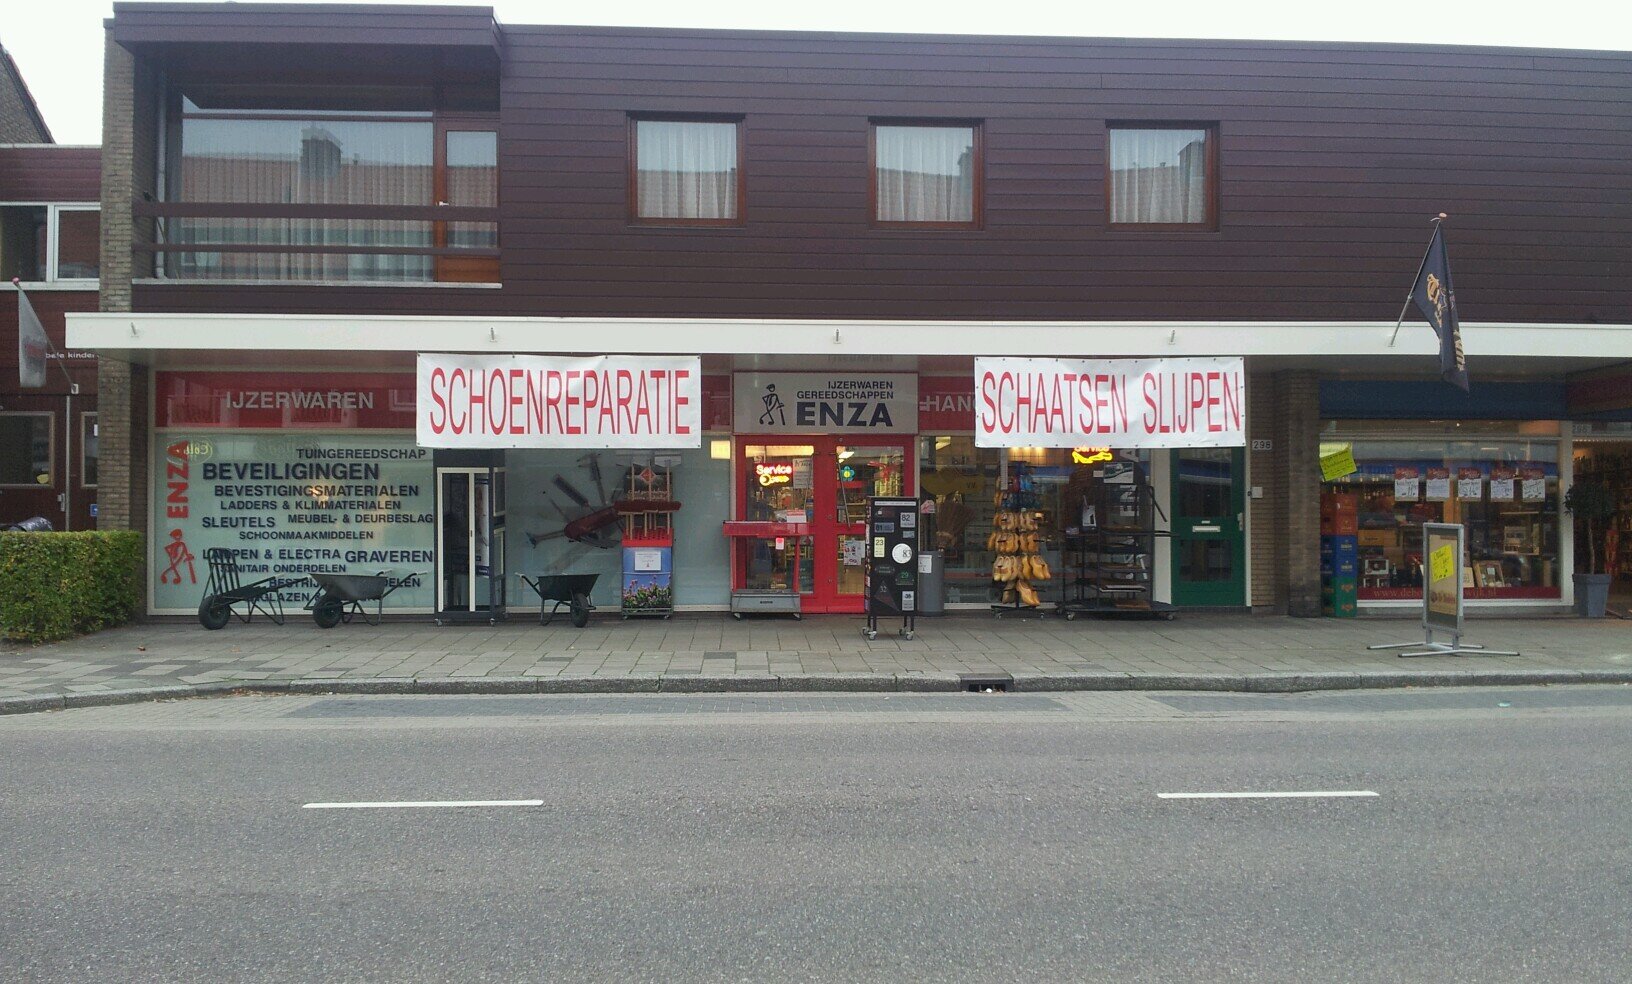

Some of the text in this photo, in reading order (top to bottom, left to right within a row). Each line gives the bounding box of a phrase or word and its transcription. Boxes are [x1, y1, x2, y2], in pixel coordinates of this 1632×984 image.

[828, 380, 893, 390] IJZERWAREN
[226, 391, 373, 409] IJZERWAREN
[430, 367, 690, 435] SCHOENREPARATIE
[797, 390, 894, 400] GEREEDSCHAPPEN
[926, 395, 975, 411] HAN
[981, 371, 1240, 434] SCHAATSEN SLIJPEN
[796, 402, 893, 427] ENZA
[296, 448, 426, 460] TUINGEREEDSCHAP
[202, 463, 379, 480] BEVEILIGINGEN
[756, 464, 792, 474] Service
[166, 440, 190, 518] ENZA
[214, 484, 419, 497] BEVESTIGINGSMATERIALEN
[220, 500, 401, 511] LADDERS & KLIMMATERIALEN
[202, 516, 275, 528] SLEUTELS
[287, 513, 433, 524] MEUBEL- & DEURBESLAG
[902, 514, 911, 522] 82
[239, 530, 374, 540] SCHOONMAAKMIDDELEN
[264, 549, 273, 559] &
[279, 549, 341, 560] ELECTRA
[344, 550, 433, 563] GRAVEREN
[273, 563, 347, 573] ONDERDELEN
